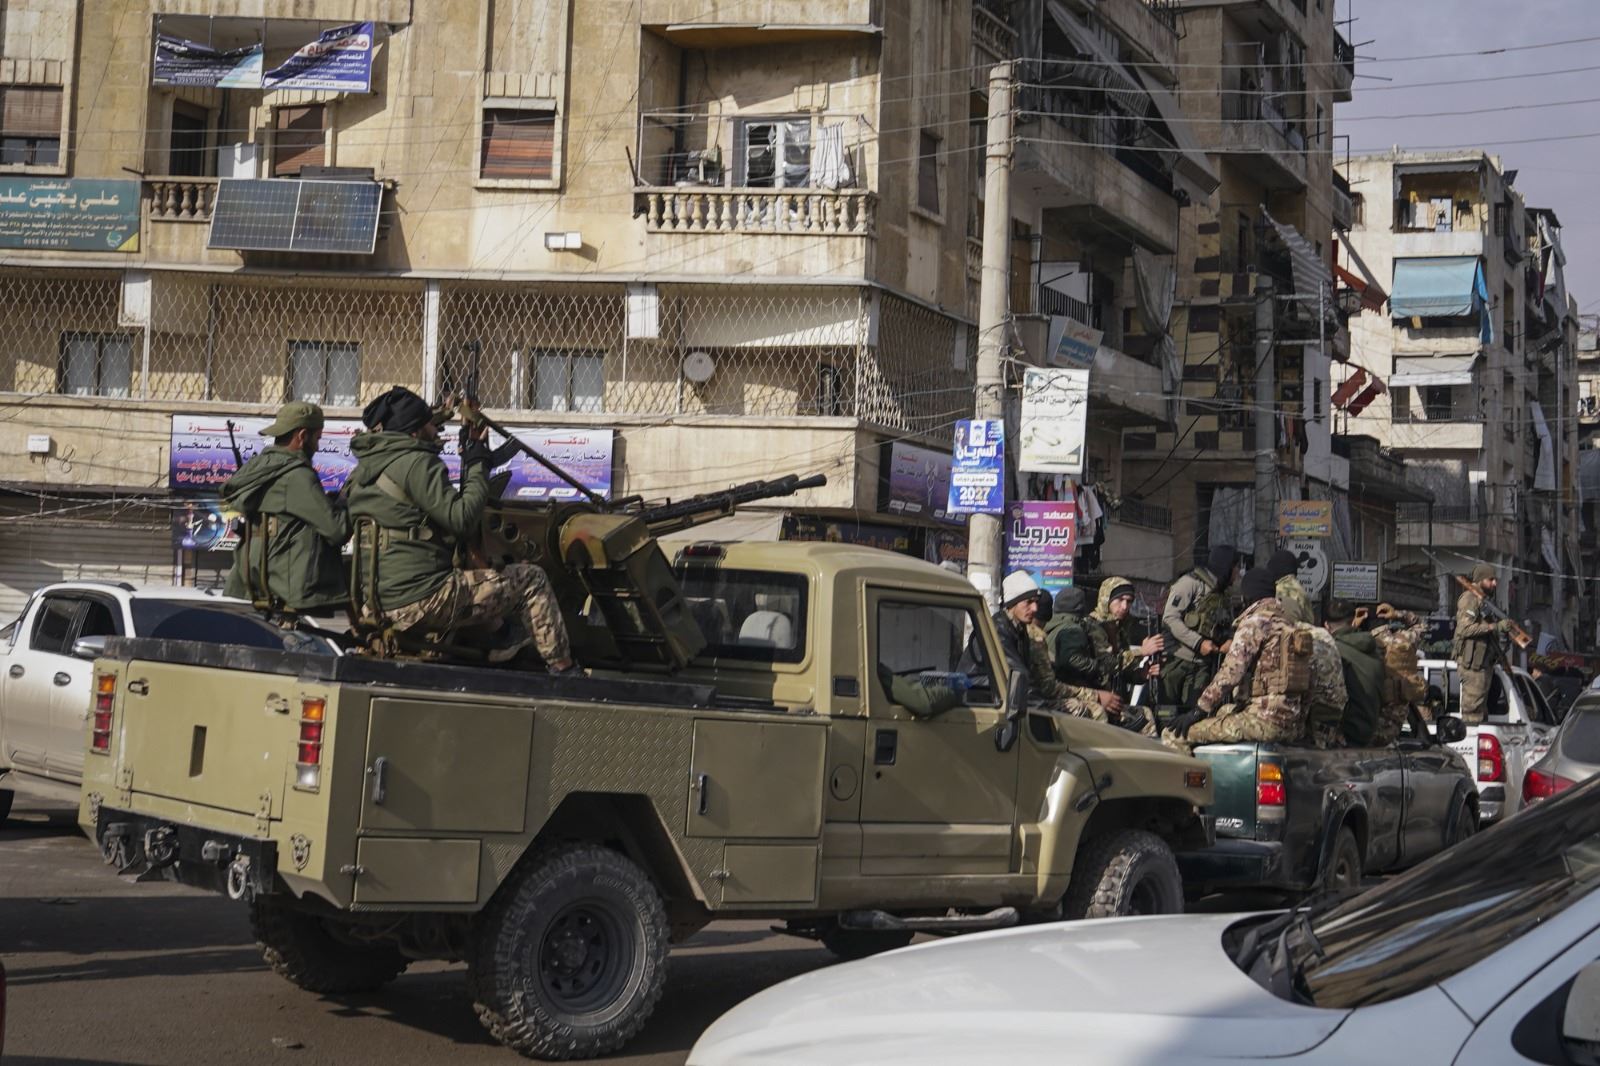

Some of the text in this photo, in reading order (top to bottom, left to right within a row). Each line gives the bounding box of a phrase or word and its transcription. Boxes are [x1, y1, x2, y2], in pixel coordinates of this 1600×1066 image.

[29, 180, 71, 191] الدكتور
[80, 189, 120, 211] علي
[543, 435, 590, 447] الدكتور
[956, 445, 997, 460] السريان
[959, 486, 990, 501] 2027
[1043, 511, 1074, 520] معهد
[1013, 519, 1070, 546] بيرويا
